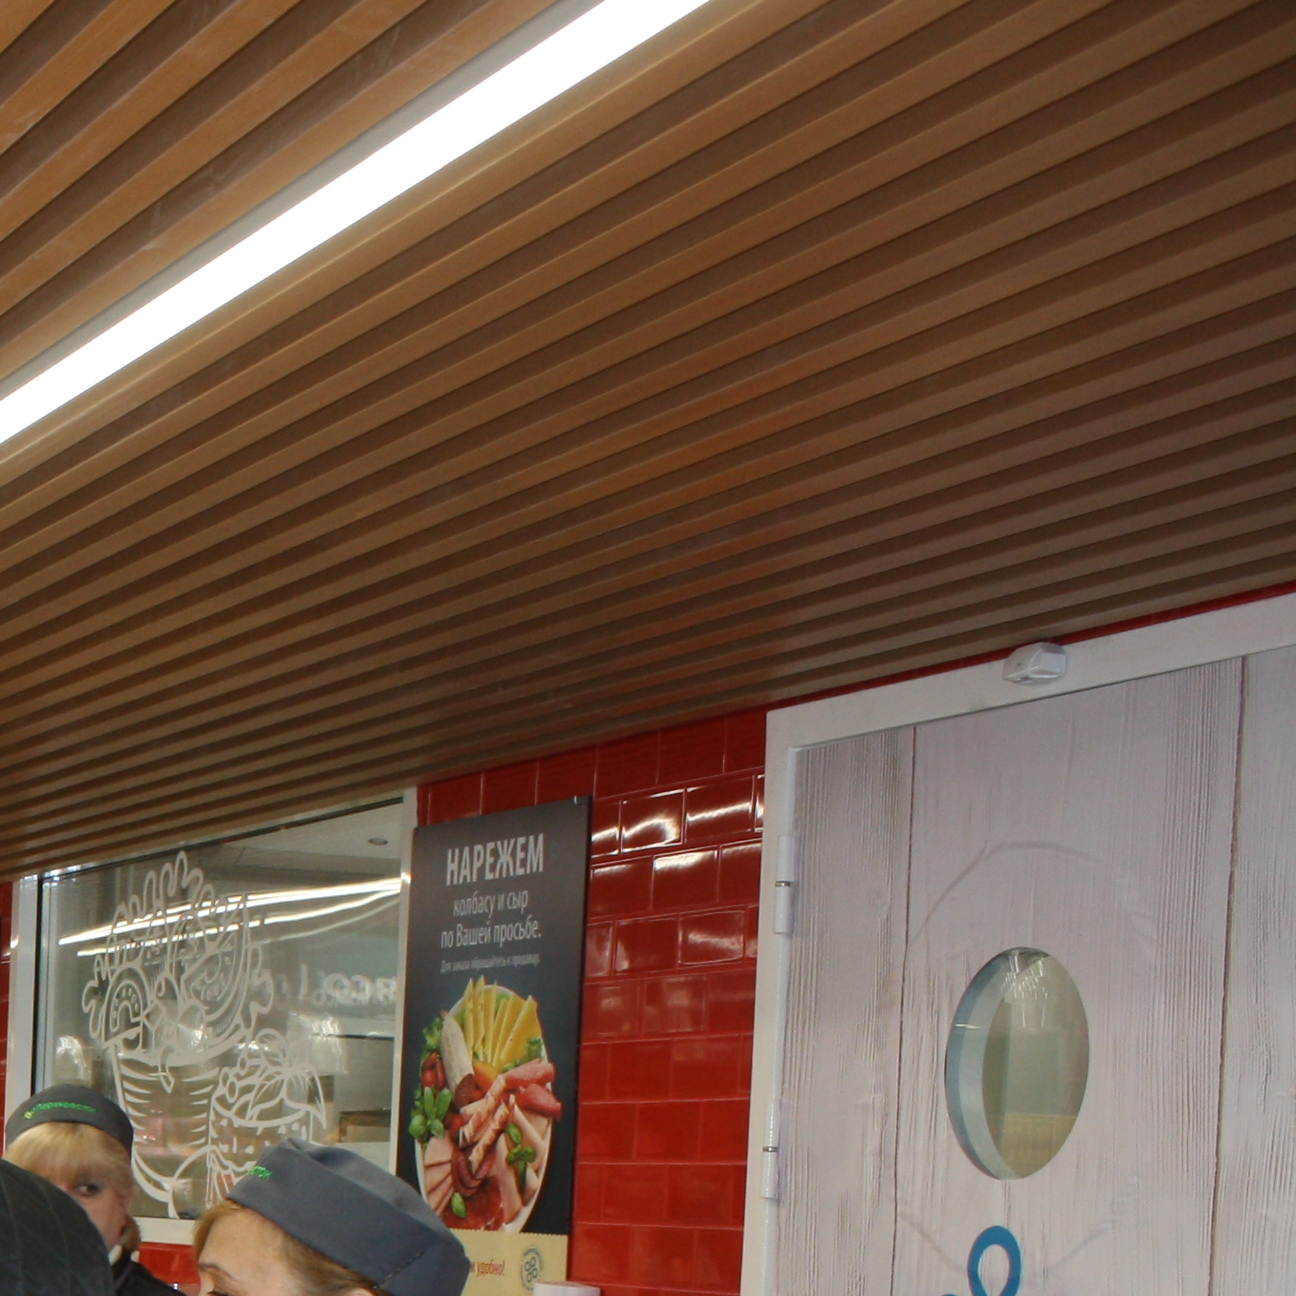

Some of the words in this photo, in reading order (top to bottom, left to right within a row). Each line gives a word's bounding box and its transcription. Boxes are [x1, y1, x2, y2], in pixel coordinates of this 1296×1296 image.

[445, 833, 544, 887] НАРЕЖЕМ
[453, 890, 496, 918] колбасу
[497, 894, 504, 911] и
[507, 890, 529, 914] сыр
[441, 930, 454, 948] по
[456, 920, 491, 947] Вашей
[493, 914, 542, 948] просьбе.
